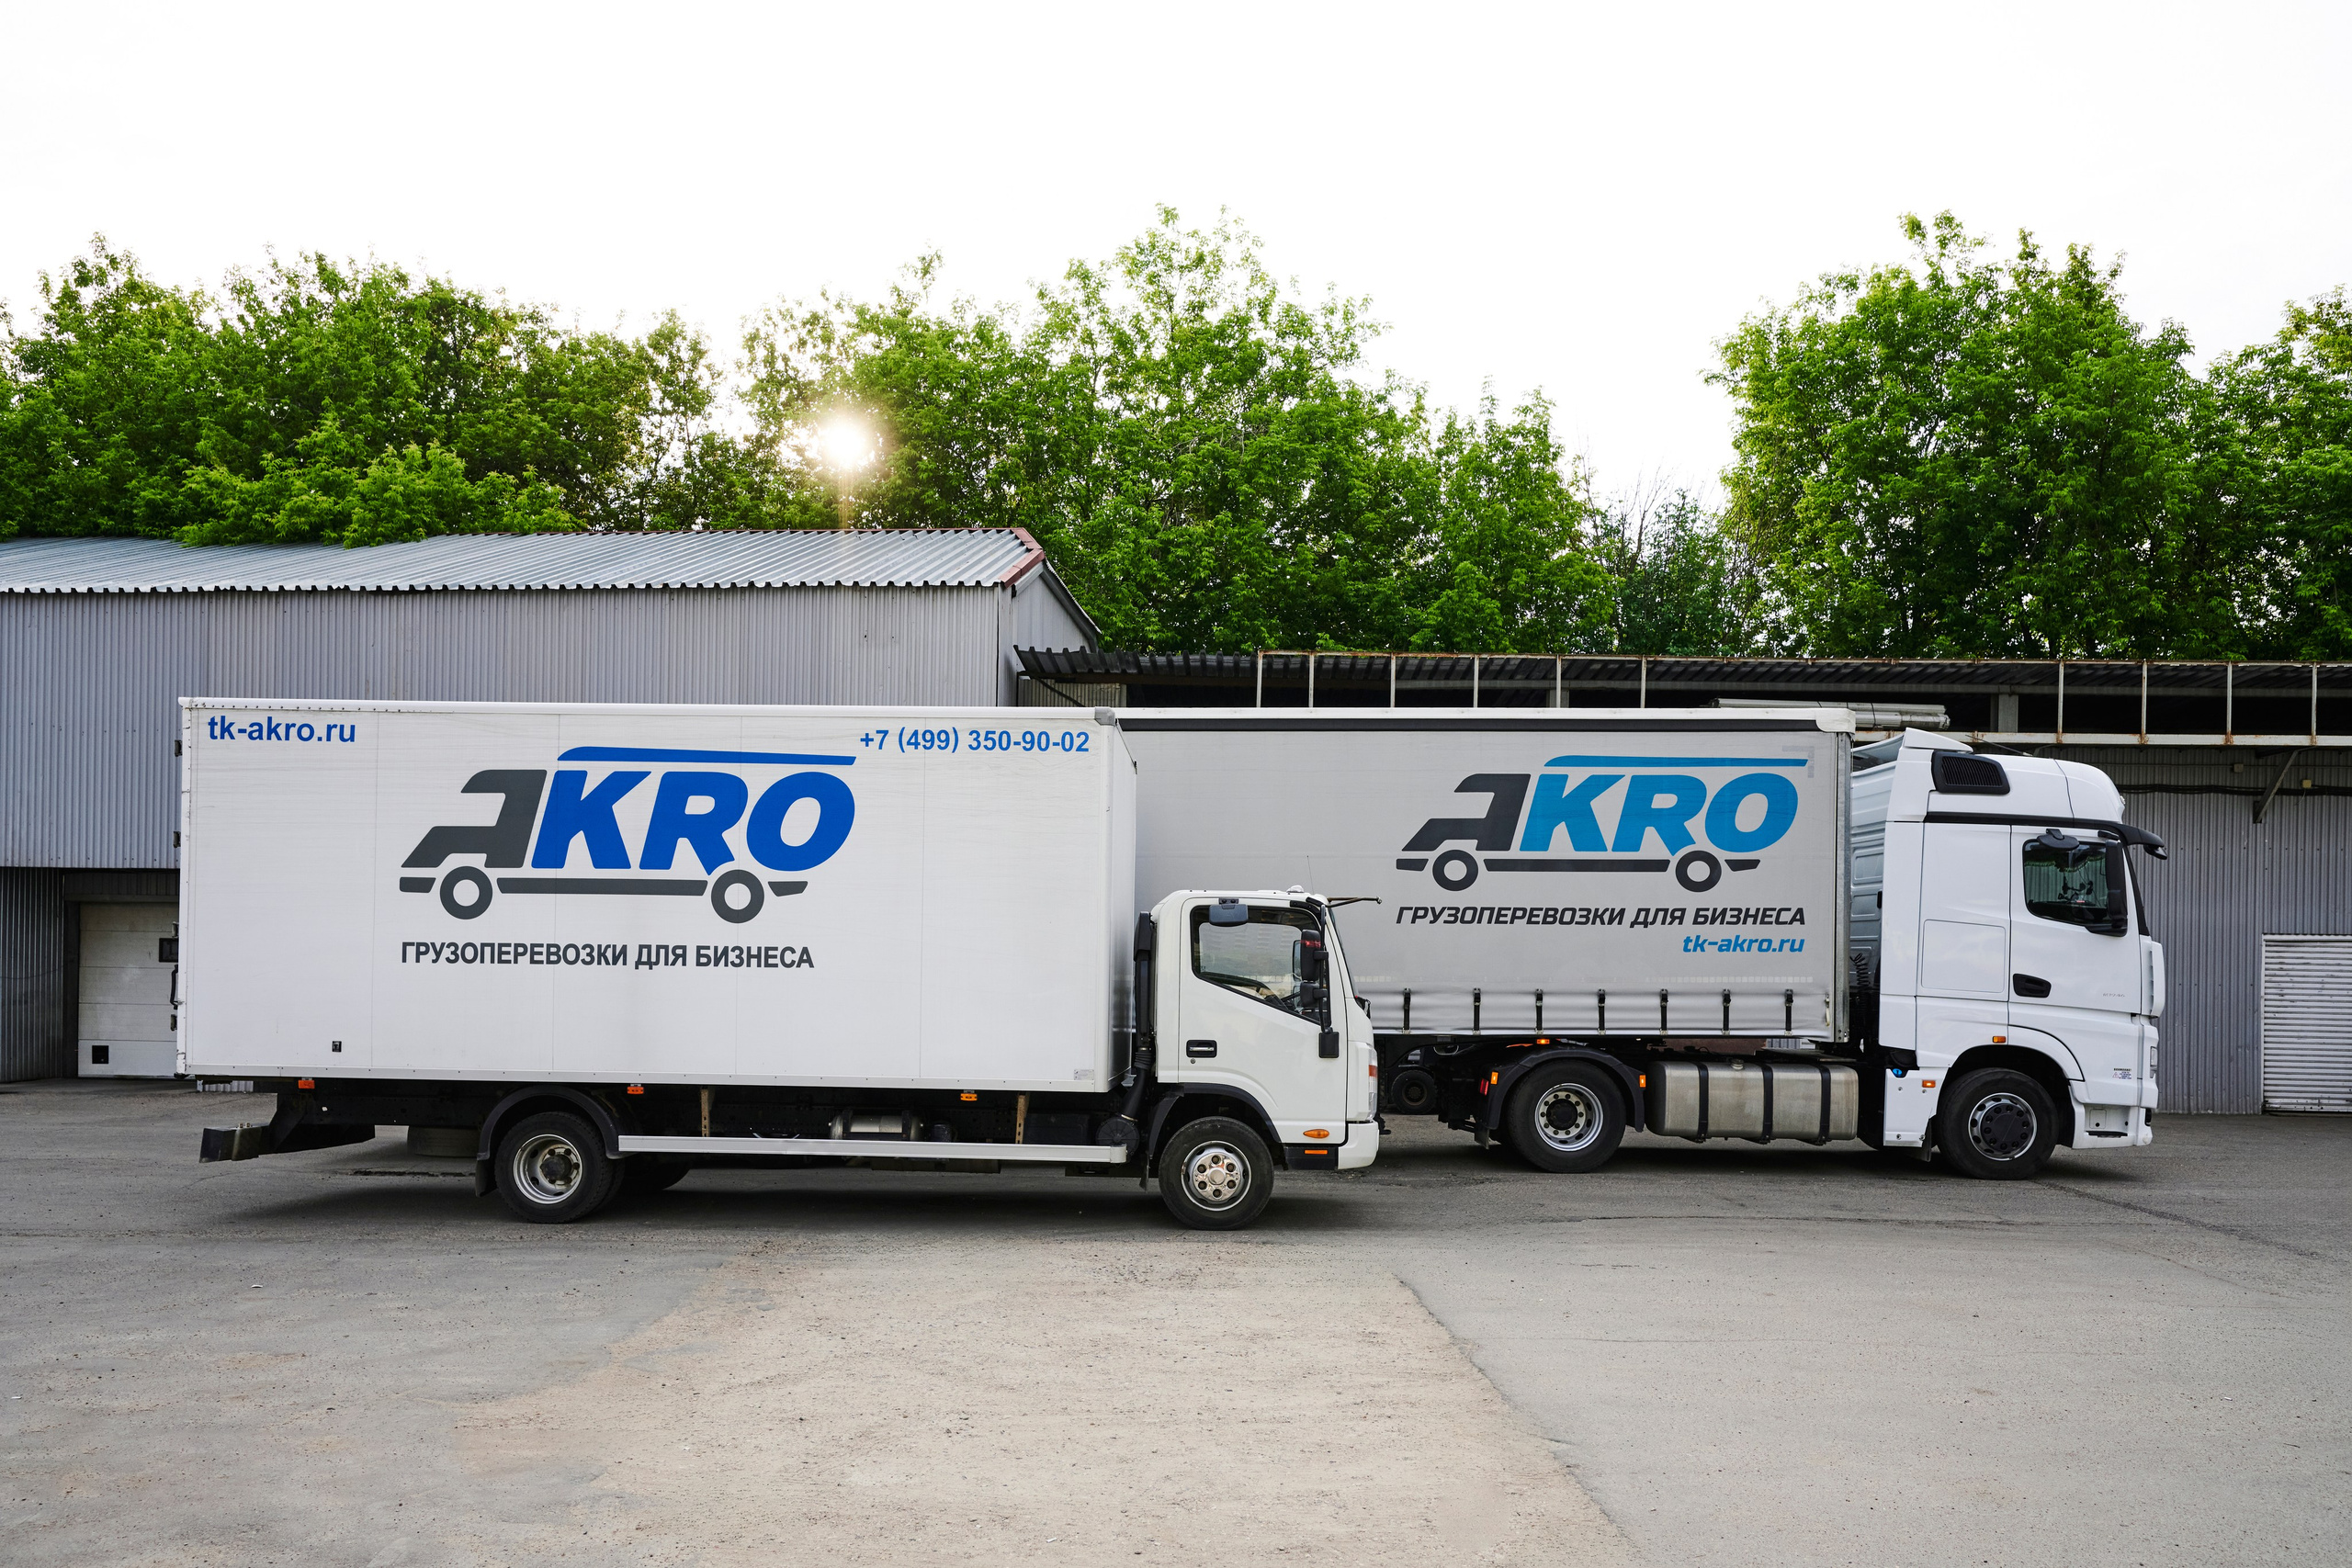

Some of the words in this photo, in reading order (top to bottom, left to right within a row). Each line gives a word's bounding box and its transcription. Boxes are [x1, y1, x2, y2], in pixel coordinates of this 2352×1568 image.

[208, 716, 356, 742] tk-akro.ru
[860, 730, 889, 750] +7
[899, 727, 958, 753] (499)
[968, 730, 1090, 752] 350-90-02
[401, 770, 854, 874] AKRO
[1402, 773, 1798, 855] AKRO
[1396, 907, 1625, 925] ГРУЗОПЕРЕВОЗКИ
[1630, 908, 1687, 928] ДЛЯ
[1692, 908, 1805, 925] БИЗНЕСА
[401, 942, 628, 965] ГРУЗОПЕРЕВОЗКИ
[635, 944, 686, 970] ДЛЯ
[695, 945, 814, 968] БИЗНЕСА
[1683, 935, 1804, 953] tk-akro.ru
